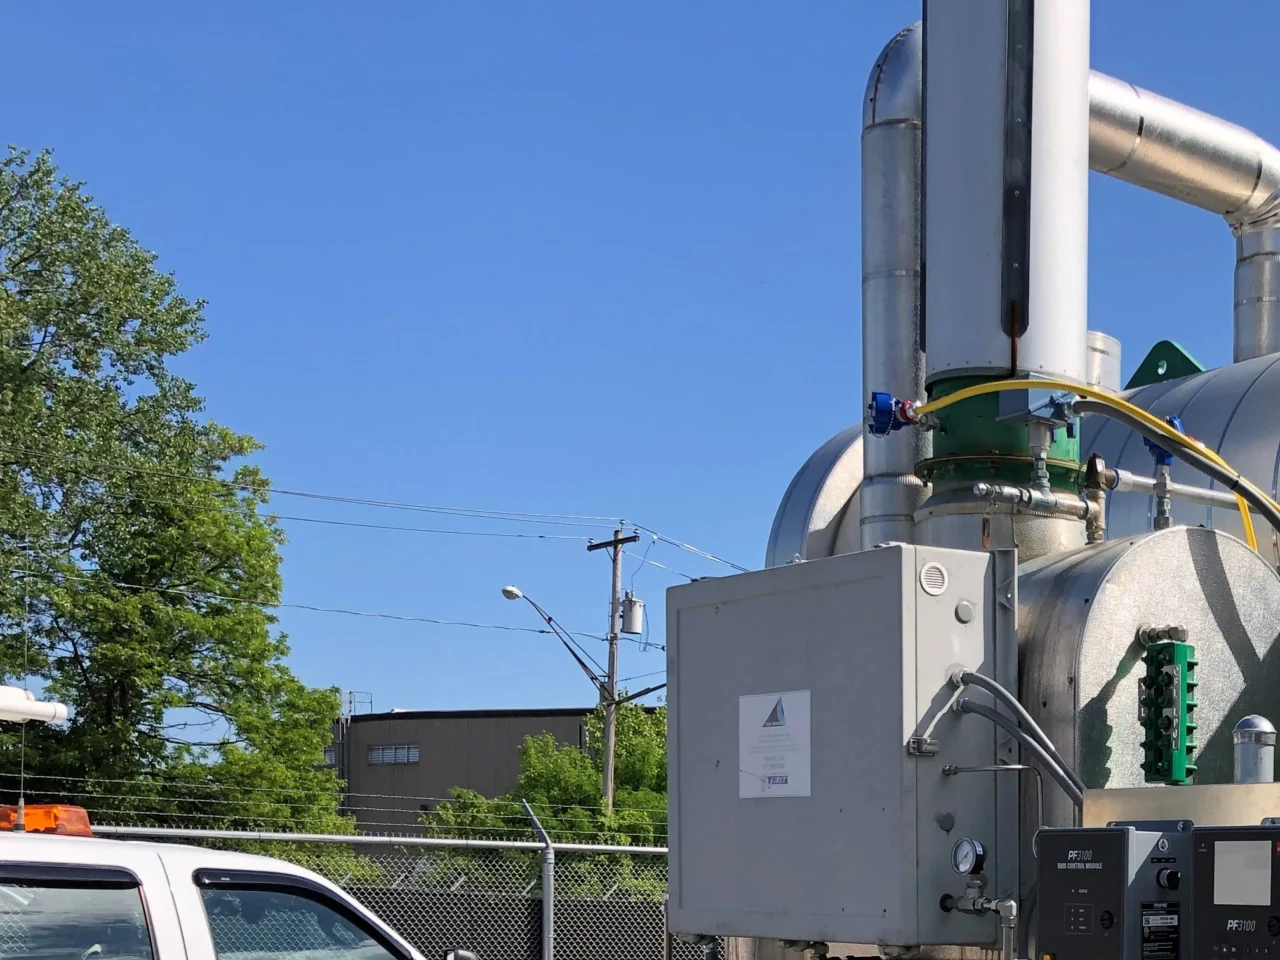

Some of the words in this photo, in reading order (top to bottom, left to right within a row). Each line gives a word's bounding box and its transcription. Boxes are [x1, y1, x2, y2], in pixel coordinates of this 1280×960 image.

[1067, 850, 1093, 861] PF3100
[1067, 862, 1085, 870] CONTROL
[1085, 862, 1103, 870] MODULE
[1227, 919, 1256, 932] PF3100
